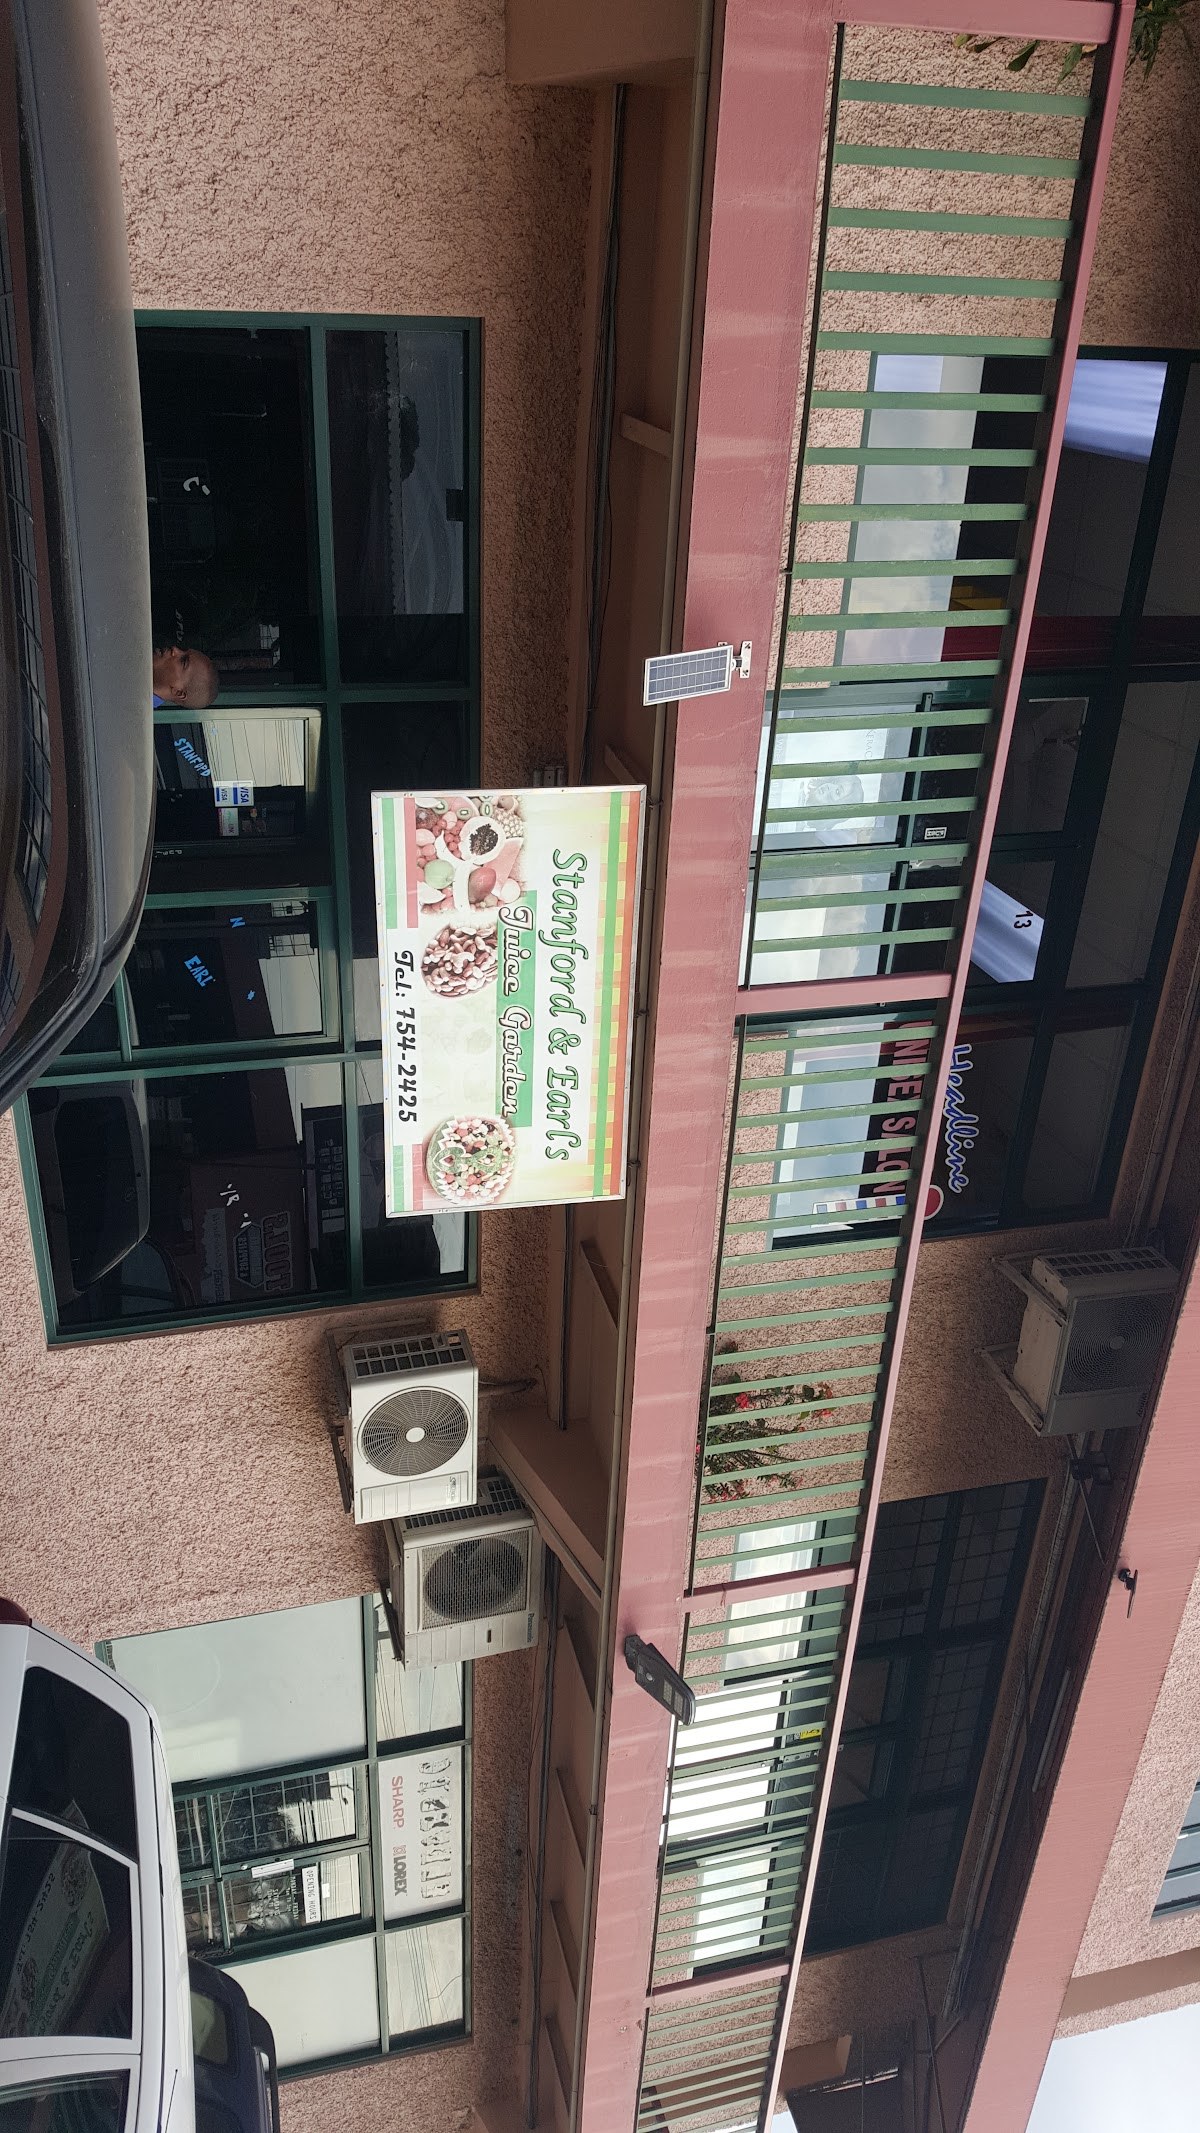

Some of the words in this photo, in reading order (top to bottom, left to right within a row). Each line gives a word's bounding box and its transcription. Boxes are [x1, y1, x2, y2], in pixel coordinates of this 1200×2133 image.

[239, 787, 248, 804] VISA
[537, 848, 588, 1025] Stanford
[1012, 910, 1033, 930] 13
[183, 954, 213, 988] EARL
[393, 950, 414, 998] Tel:
[497, 906, 533, 997] Juice
[394, 1006, 416, 1124] 754-2425
[498, 1005, 532, 1119] Garden
[546, 1027, 582, 1056] &
[886, 1020, 932, 1102] NIE
[543, 1066, 581, 1162] Earl's
[942, 1044, 979, 1193] Headline
[872, 1116, 916, 1194] SLON
[390, 1776, 404, 1829] SHARP
[305, 1870, 315, 1898] OPENING
[392, 1855, 407, 1897] LOREX
[308, 1900, 316, 1920] HOURS
